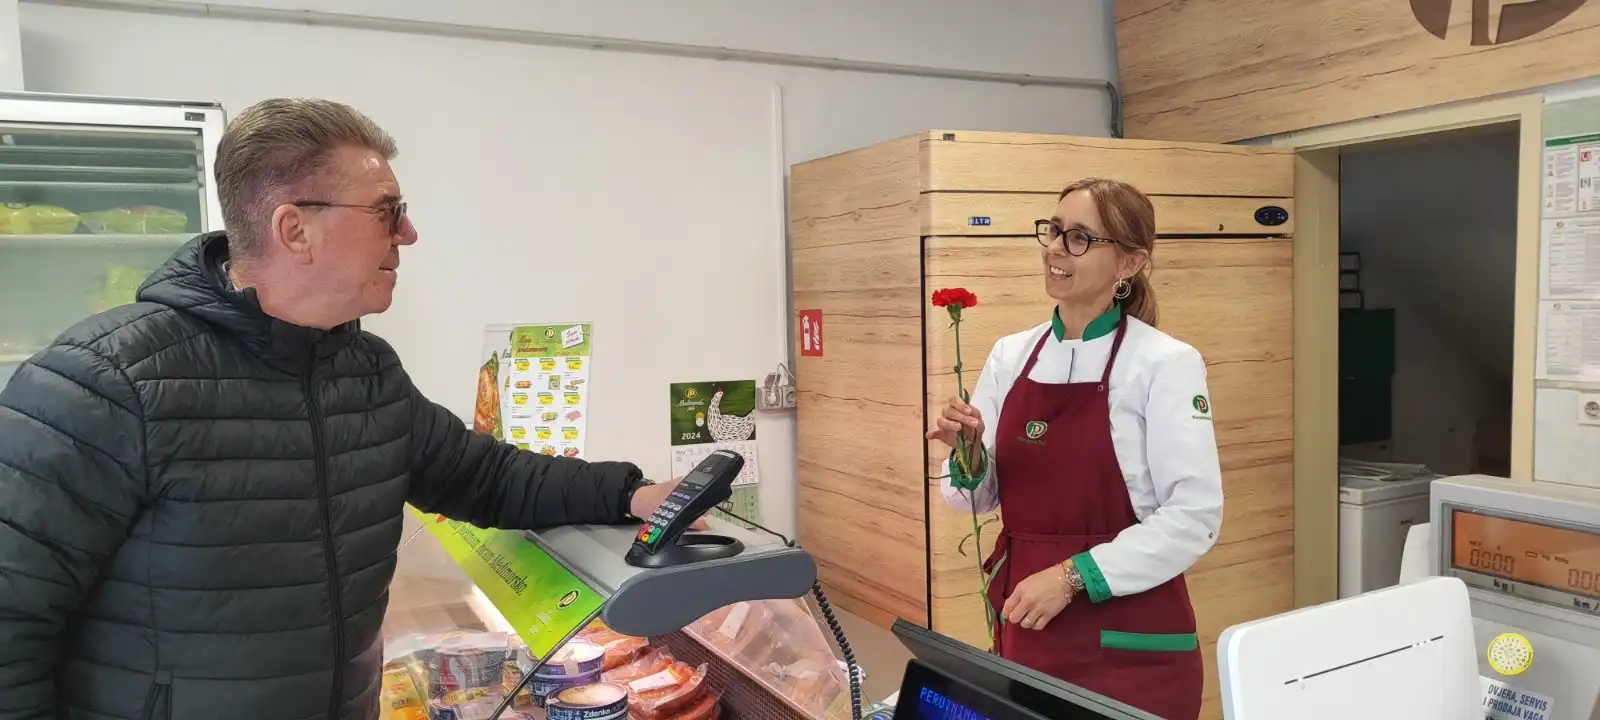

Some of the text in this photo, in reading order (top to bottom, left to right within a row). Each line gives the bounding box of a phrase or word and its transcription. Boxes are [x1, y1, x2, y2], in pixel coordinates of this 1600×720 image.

[681, 432, 701, 440] 2024
[1487, 698, 1522, 718] PRODAJA
[1520, 694, 1548, 711] SERVIS
[584, 708, 610, 719] Zdenka
